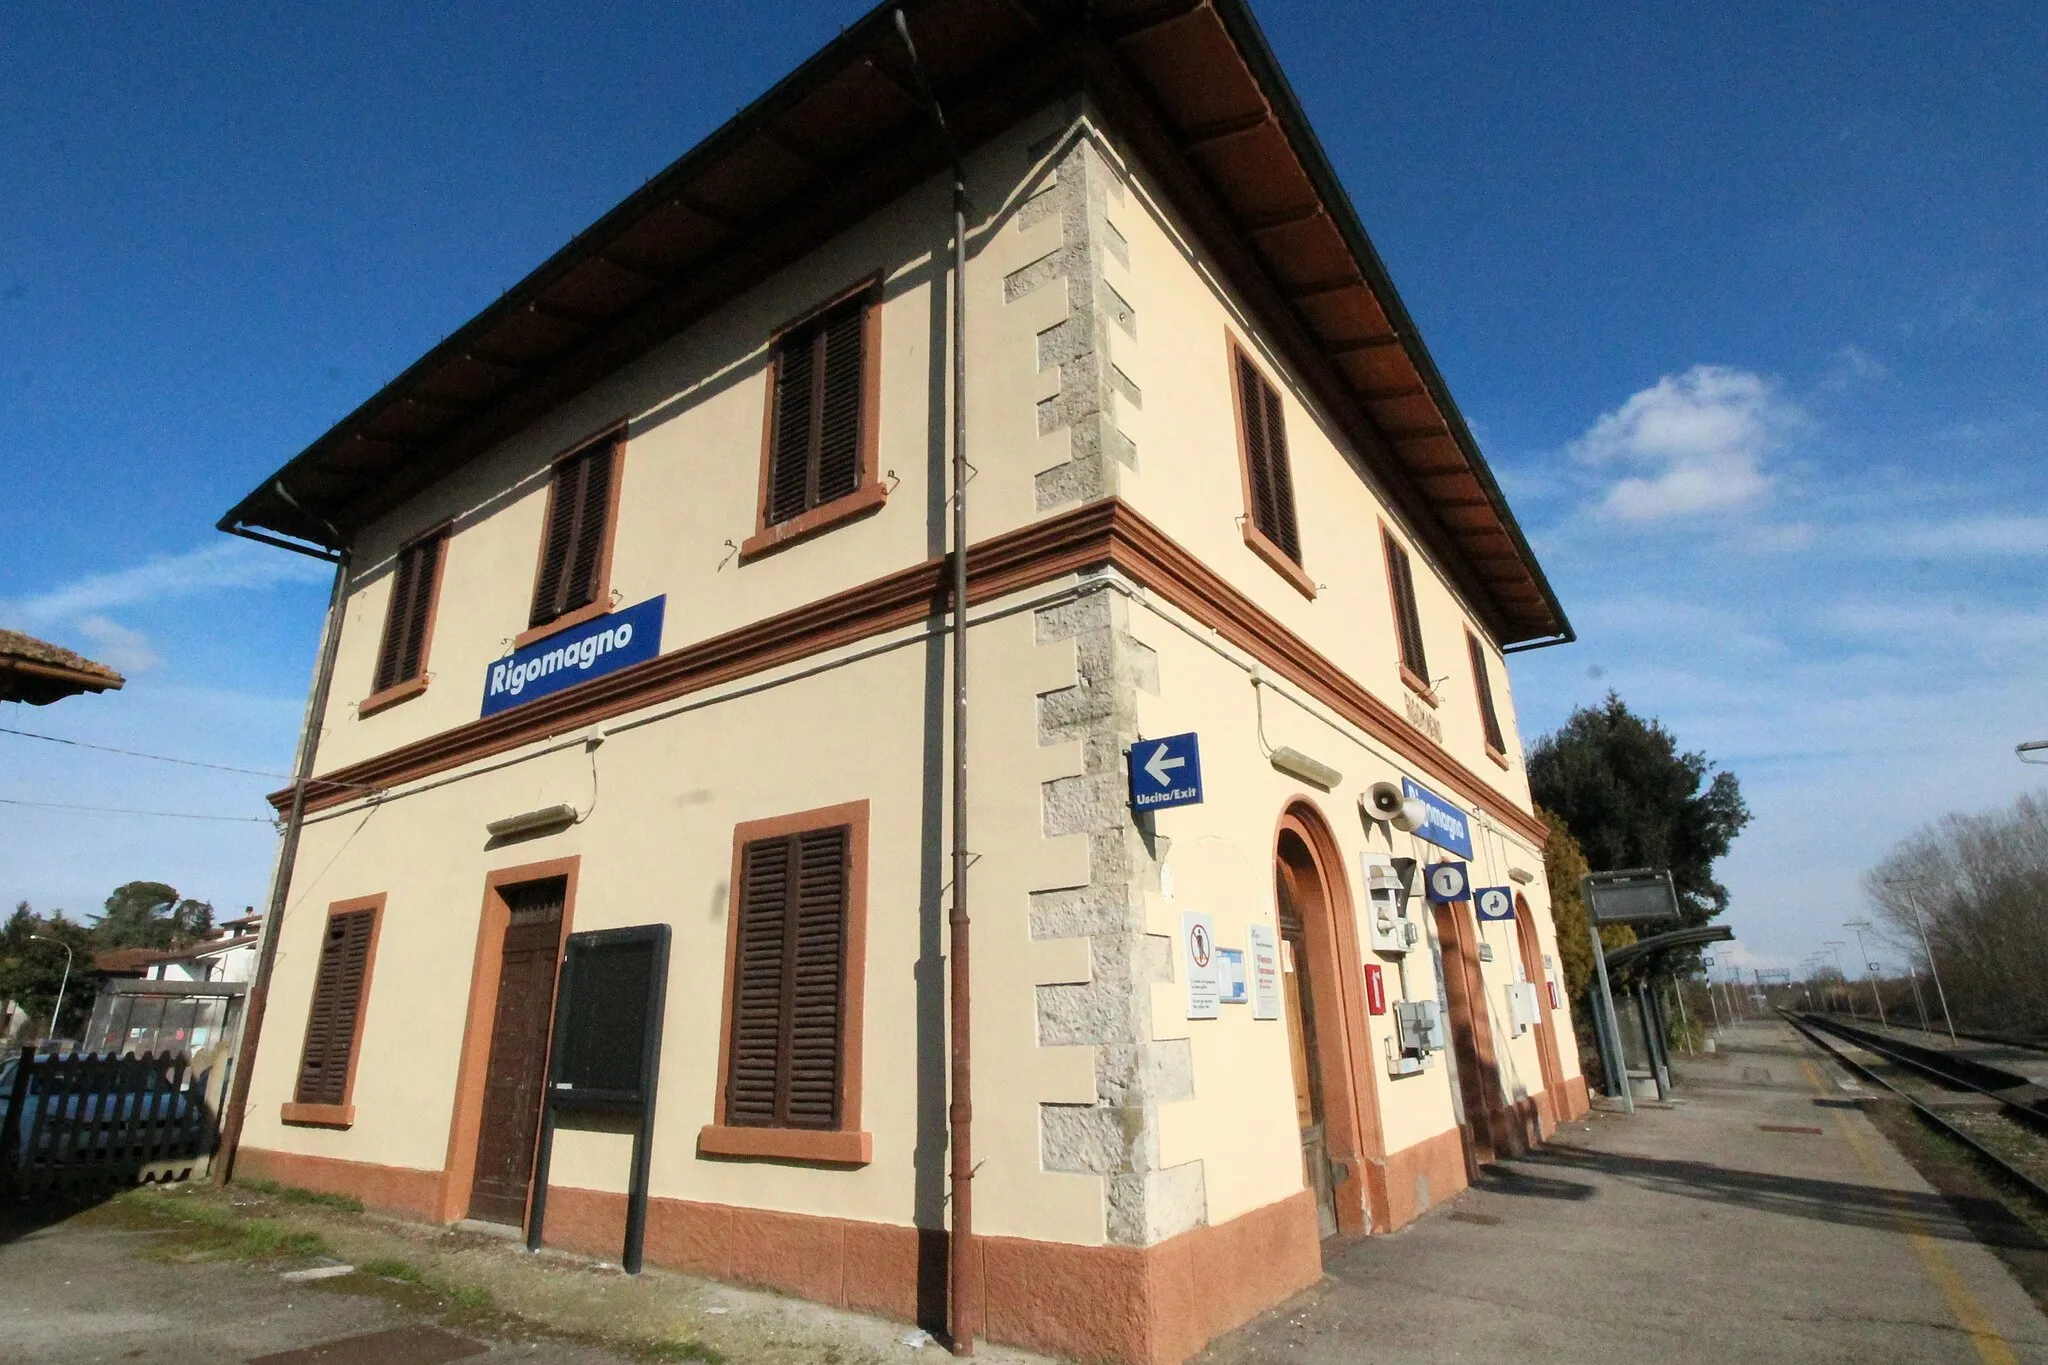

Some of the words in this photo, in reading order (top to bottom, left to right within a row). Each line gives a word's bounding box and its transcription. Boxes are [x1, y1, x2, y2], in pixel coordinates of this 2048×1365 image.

[490, 623, 633, 696] Rigomagno
[1137, 788, 1196, 805] Uscita/Exit
[1443, 875, 1451, 890] 1
